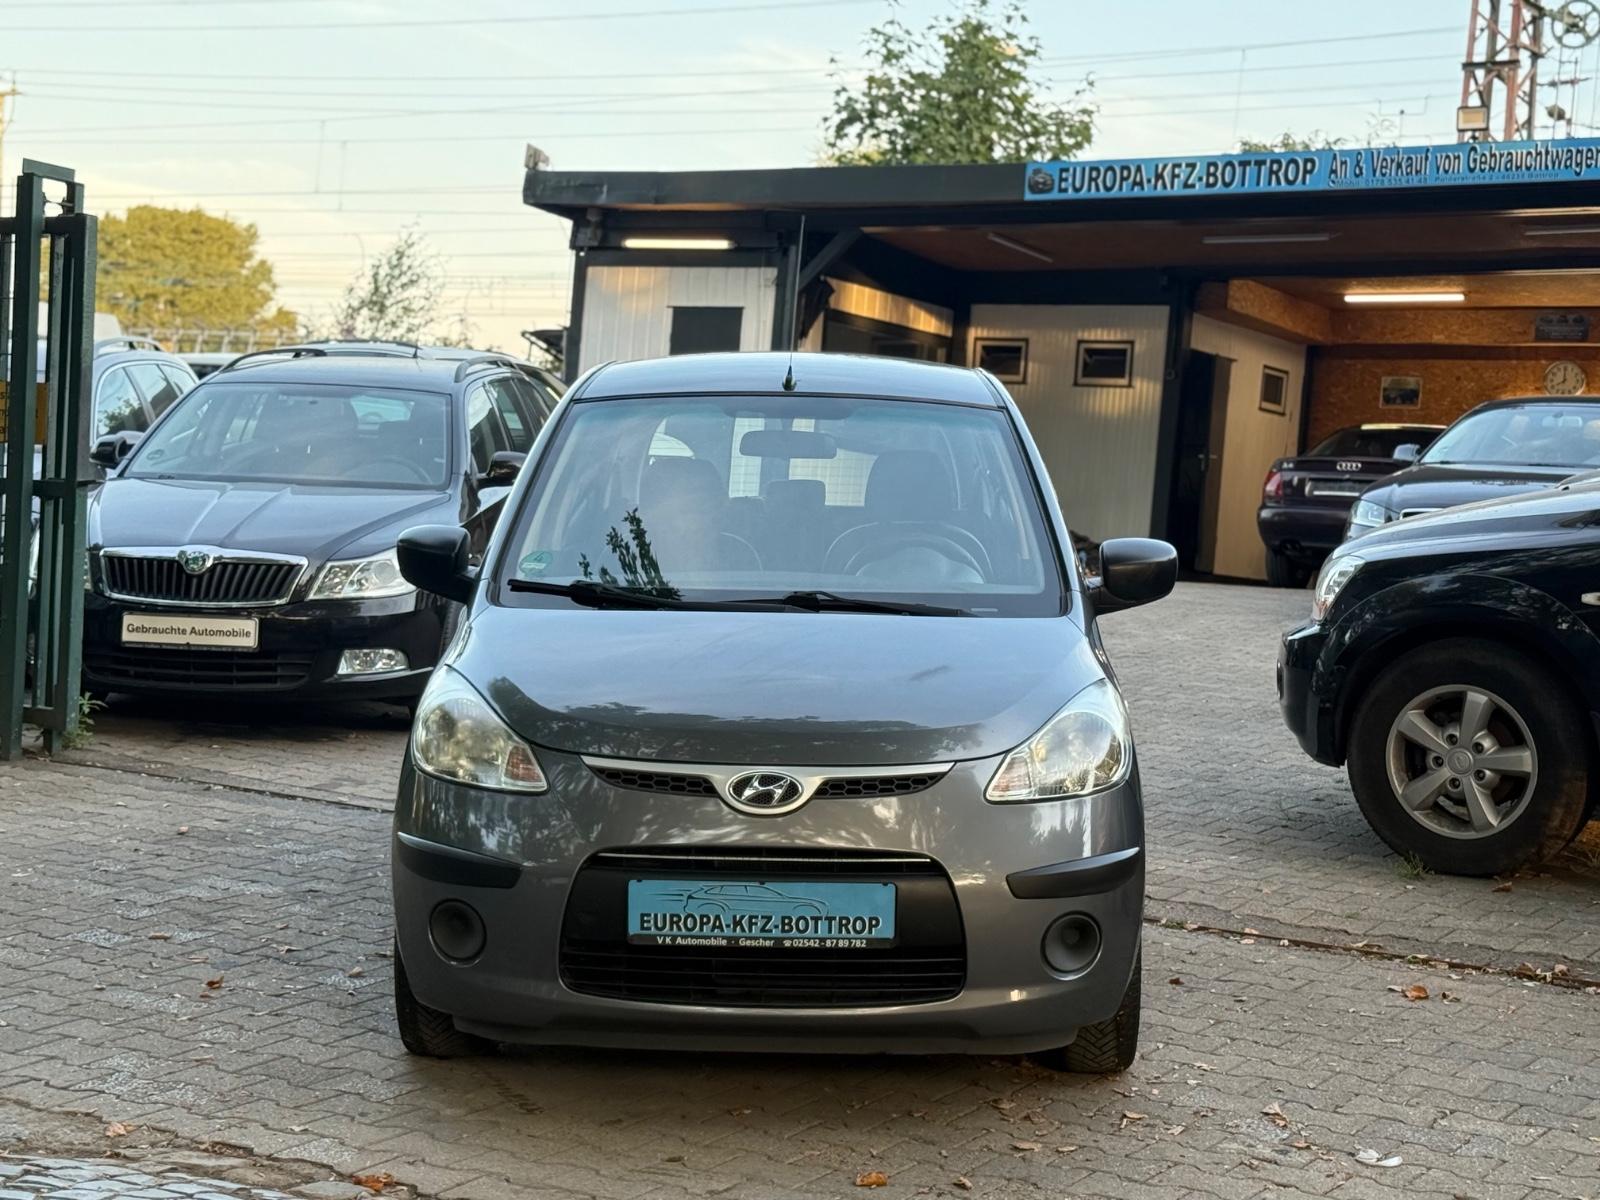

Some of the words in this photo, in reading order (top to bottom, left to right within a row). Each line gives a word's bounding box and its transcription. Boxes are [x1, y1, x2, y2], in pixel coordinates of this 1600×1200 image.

[1057, 156, 1319, 194] EUROPA-KFZ-BOTTROP
[1329, 151, 1350, 179] An
[1354, 150, 1366, 178] &
[1371, 147, 1432, 177] Verkauf
[1435, 152, 1463, 174] von
[126, 623, 187, 636] Gebrauchte
[189, 626, 252, 638] Automobile
[639, 912, 882, 936] EUROPA-KFZ-BOTTROP
[675, 936, 728, 946] Automobile
[738, 938, 774, 947] Gescher
[792, 939, 820, 947] 02542
[850, 939, 867, 948] 782
